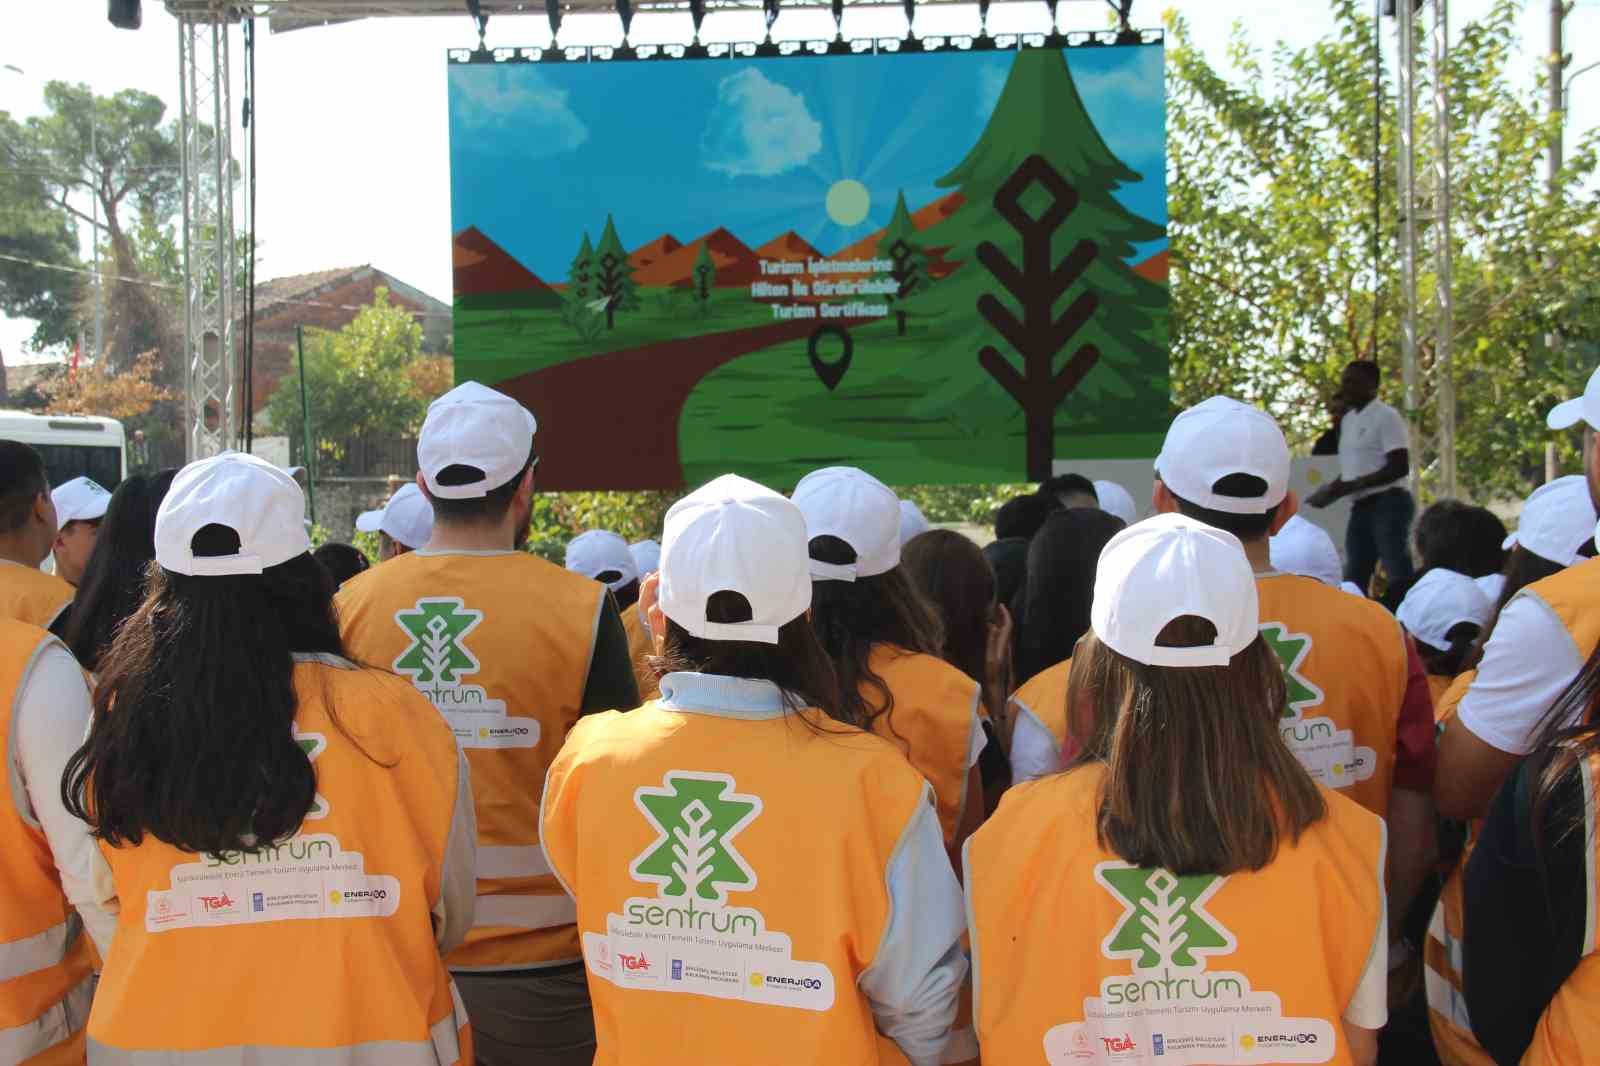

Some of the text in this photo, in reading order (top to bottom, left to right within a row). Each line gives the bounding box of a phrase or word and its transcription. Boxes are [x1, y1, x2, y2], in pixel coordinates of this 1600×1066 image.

[420, 681, 482, 704] ntrum
[628, 897, 757, 936] sentrum
[617, 951, 652, 973] TGA
[1106, 967, 1242, 1005] sentrum
[1100, 1032, 1137, 1057] TGA
